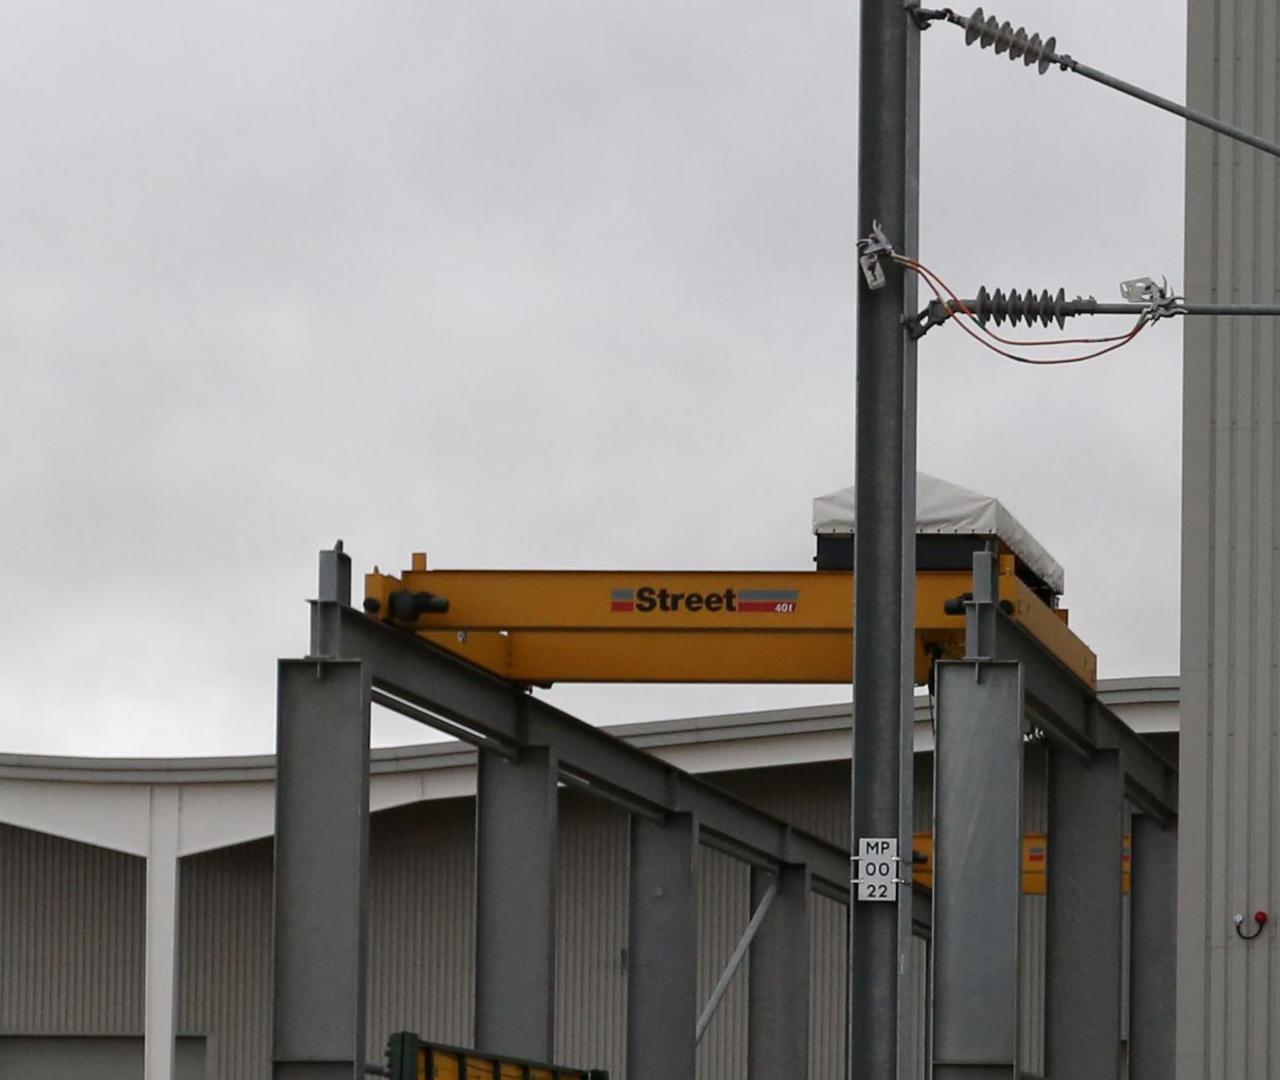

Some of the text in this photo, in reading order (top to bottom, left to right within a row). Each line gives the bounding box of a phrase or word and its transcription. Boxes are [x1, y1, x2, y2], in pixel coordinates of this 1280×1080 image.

[636, 587, 736, 612] Street
[866, 841, 890, 855] MP
[865, 862, 890, 877] 00
[866, 884, 888, 898] 22
